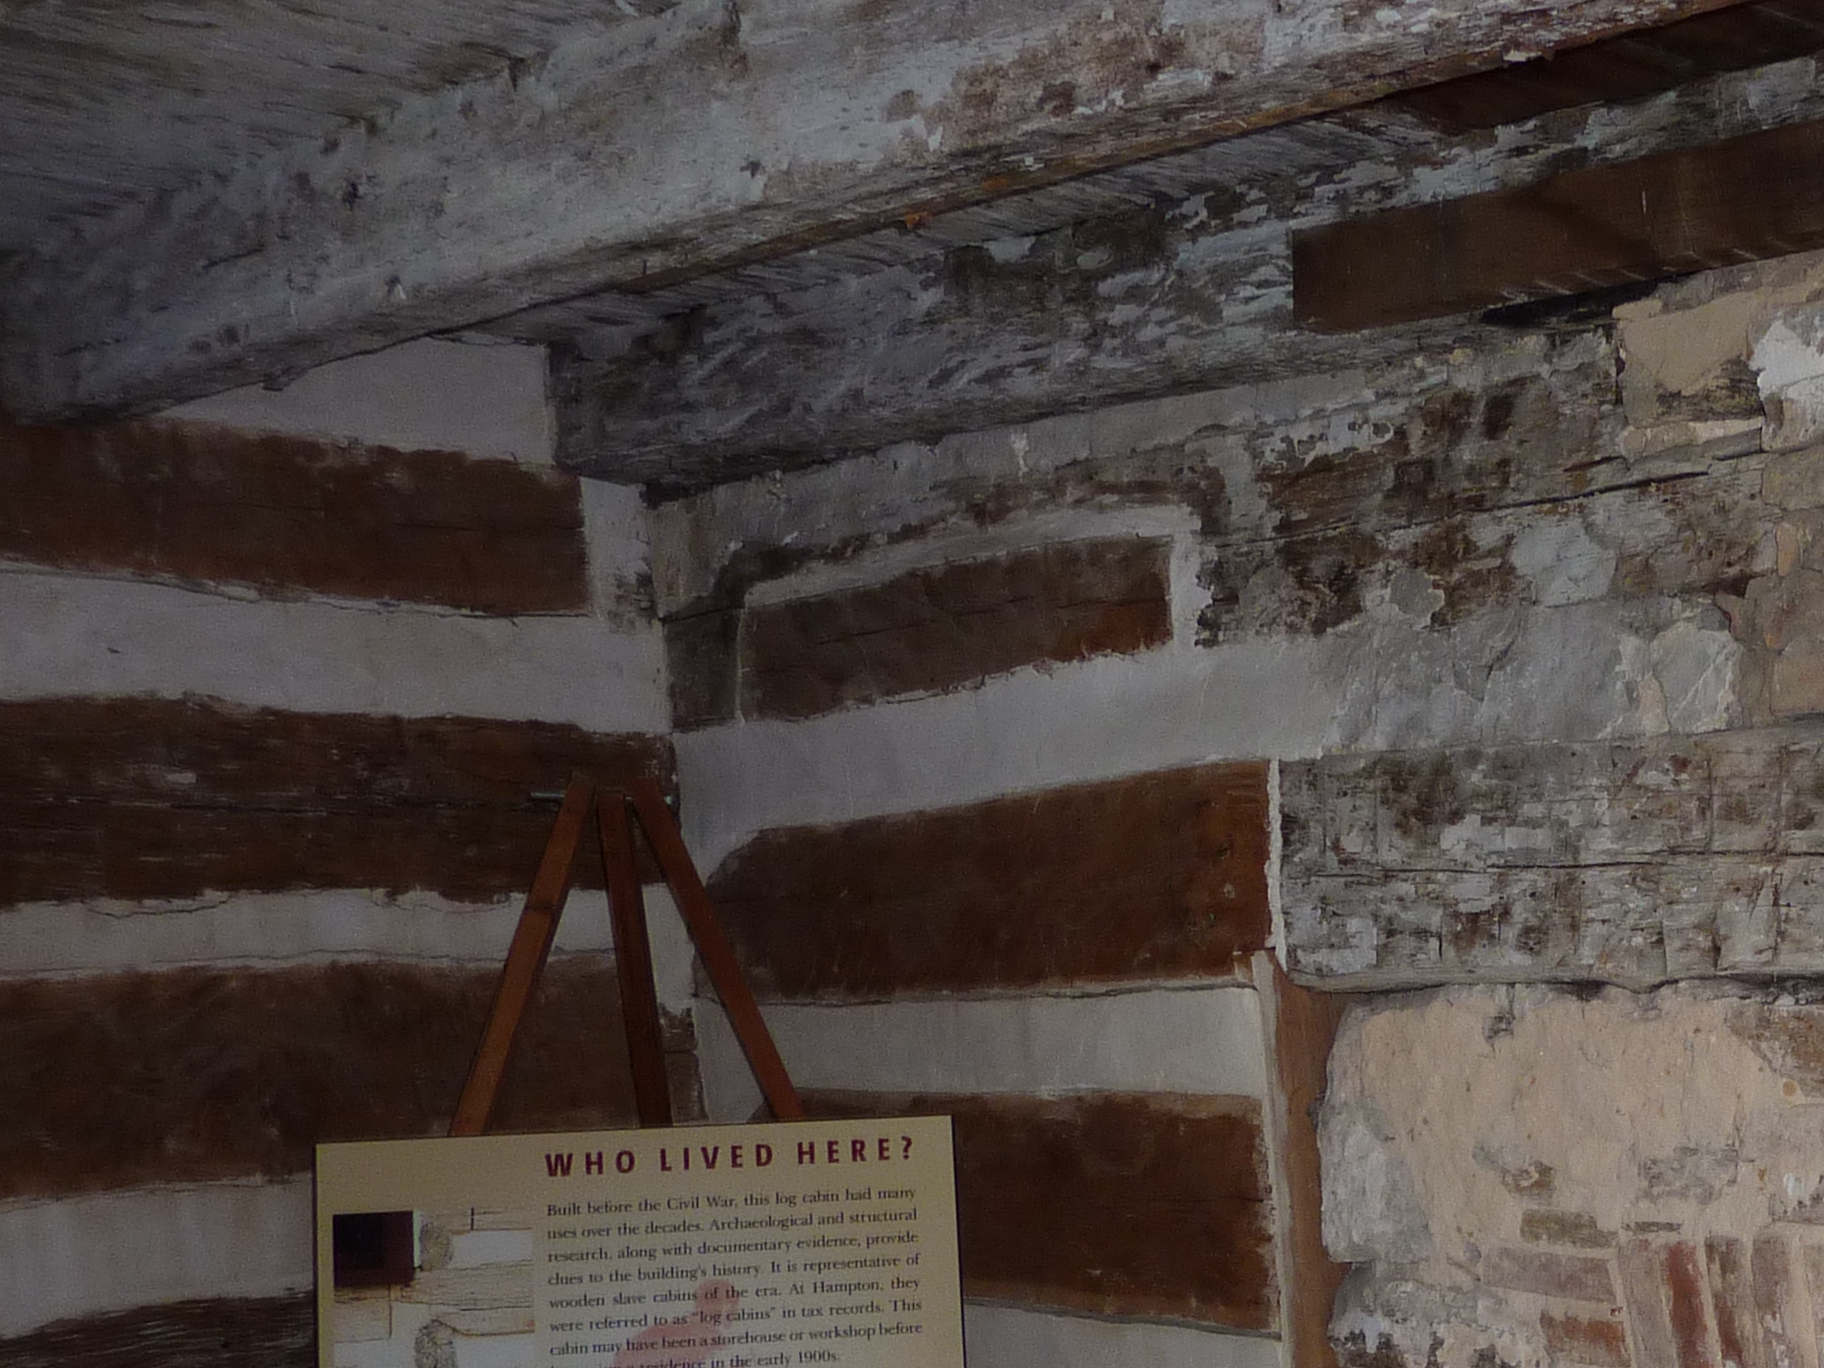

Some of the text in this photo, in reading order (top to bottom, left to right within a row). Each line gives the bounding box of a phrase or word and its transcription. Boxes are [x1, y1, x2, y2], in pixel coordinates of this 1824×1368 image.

[545, 1135, 913, 1177] WHO LIVED HERE?
[546, 1187, 916, 1216] Built before the Civil War, this log cabin had many
[547, 1207, 917, 1239] uses over the decades. Archaeological and structural
[617, 1244, 657, 1261] along
[662, 1242, 693, 1256] with
[697, 1240, 792, 1255] documentary
[796, 1235, 861, 1249] evidence,
[866, 1230, 919, 1250] provide
[547, 1273, 583, 1286] clues
[589, 1273, 604, 1283] to
[609, 1269, 632, 1282] the
[637, 1263, 707, 1281] building's
[770, 1260, 782, 1273] It
[787, 1258, 798, 1272] is
[803, 1256, 901, 1274] representative
[906, 1253, 921, 1266] of
[549, 1276, 920, 1308] wooden slave cabins of the era. At Hampton, they
[549, 1321, 584, 1332] were
[589, 1314, 648, 1329] referred
[653, 1316, 668, 1327] to
[672, 1315, 688, 1325] as
[782, 1307, 796, 1318] in
[801, 1307, 824, 1317] tax
[829, 1301, 885, 1316] records.
[888, 1299, 922, 1311] This
[550, 1322, 923, 1356] cabin may have been a storehouse or workshop before
[730, 1354, 752, 1368] the
[757, 1352, 791, 1368] early
[798, 1350, 841, 1364] 1900s.
